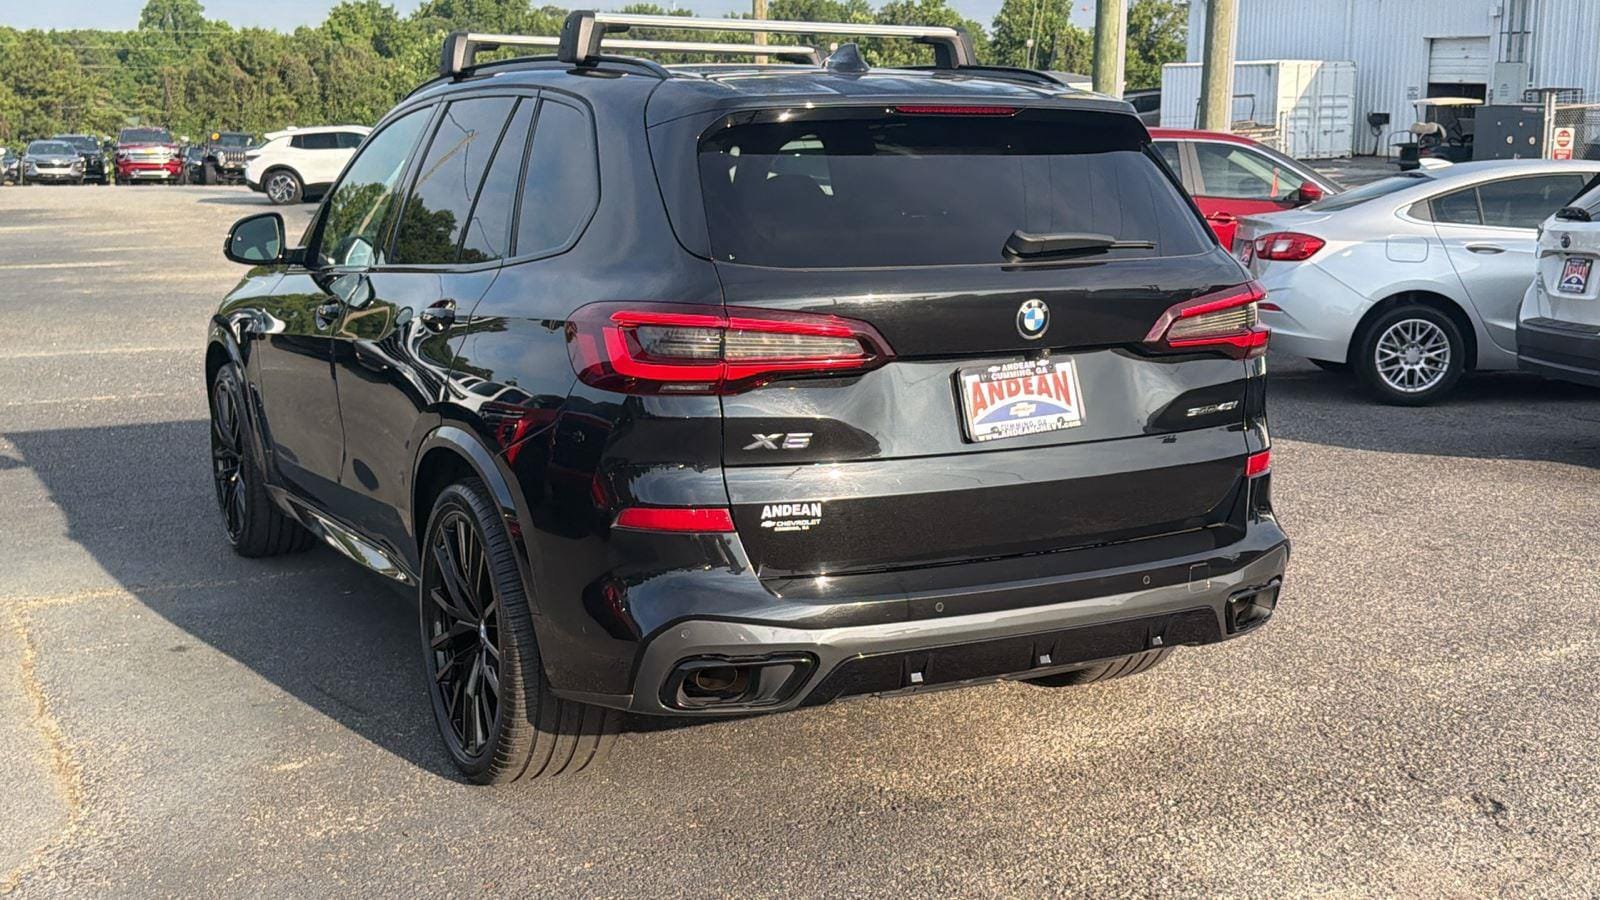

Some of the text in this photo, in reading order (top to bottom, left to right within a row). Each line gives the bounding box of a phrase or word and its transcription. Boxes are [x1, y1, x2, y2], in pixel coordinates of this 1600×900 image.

[1001, 361, 1036, 373] ANDEAN
[1036, 366, 1048, 374] GA
[972, 371, 1072, 418] ANDEAN
[742, 433, 814, 450] X5
[761, 503, 822, 520] ANDEAN
[776, 519, 822, 528] CHEVROLET
